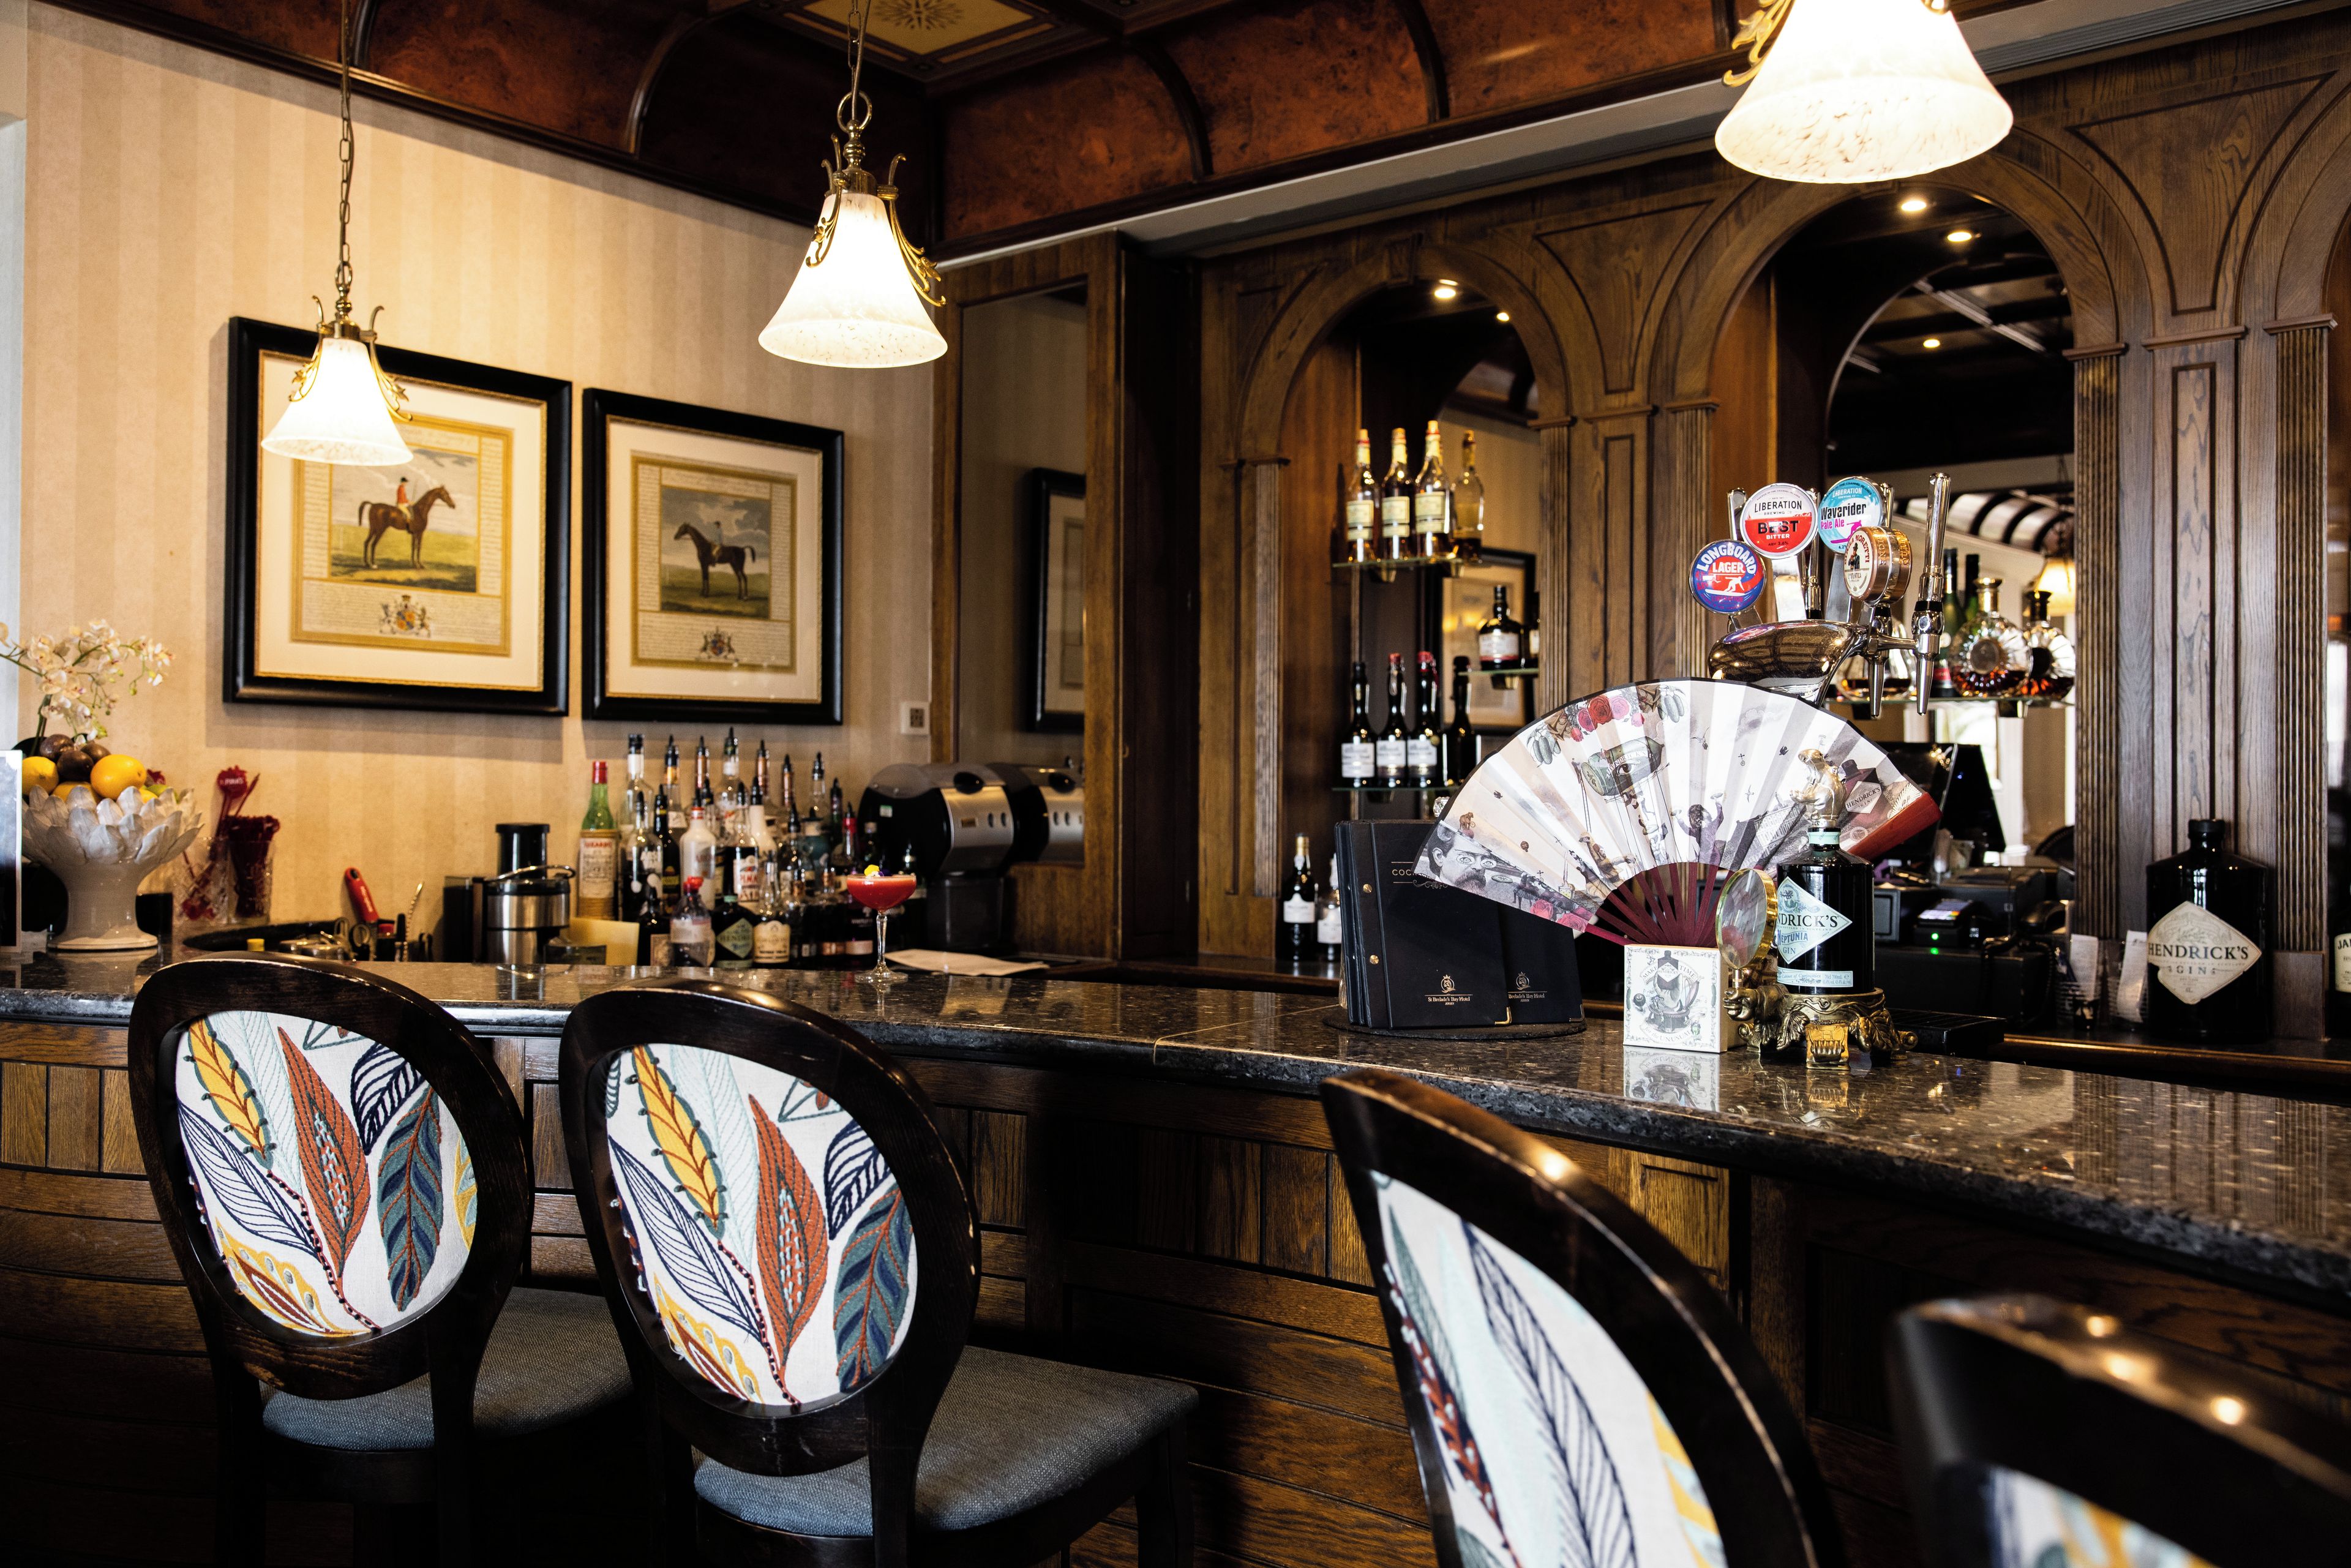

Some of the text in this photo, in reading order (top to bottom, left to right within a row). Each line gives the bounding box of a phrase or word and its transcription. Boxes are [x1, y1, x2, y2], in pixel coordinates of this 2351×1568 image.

[1832, 487, 1862, 498] LIBERATION
[1755, 500, 1802, 512] LIBERATION
[1821, 503, 1866, 520] Waverider
[1758, 520, 1799, 534] BEST
[1821, 519, 1845, 530] Pale Ale
[1856, 535, 1870, 563] MORETTI
[1697, 544, 1757, 574] LONGBOARD
[1712, 562, 1745, 573] LAGER
[1846, 787, 1880, 808] HENDRICK'S
[1777, 929, 1808, 945] NEPTUNIA
[2148, 943, 2249, 959] HENDRICK'S
[2338, 939, 2351, 950] JA
[1643, 966, 1658, 979] MAKE
[1679, 966, 1695, 978] TIME
[2177, 966, 2207, 975] GIN
